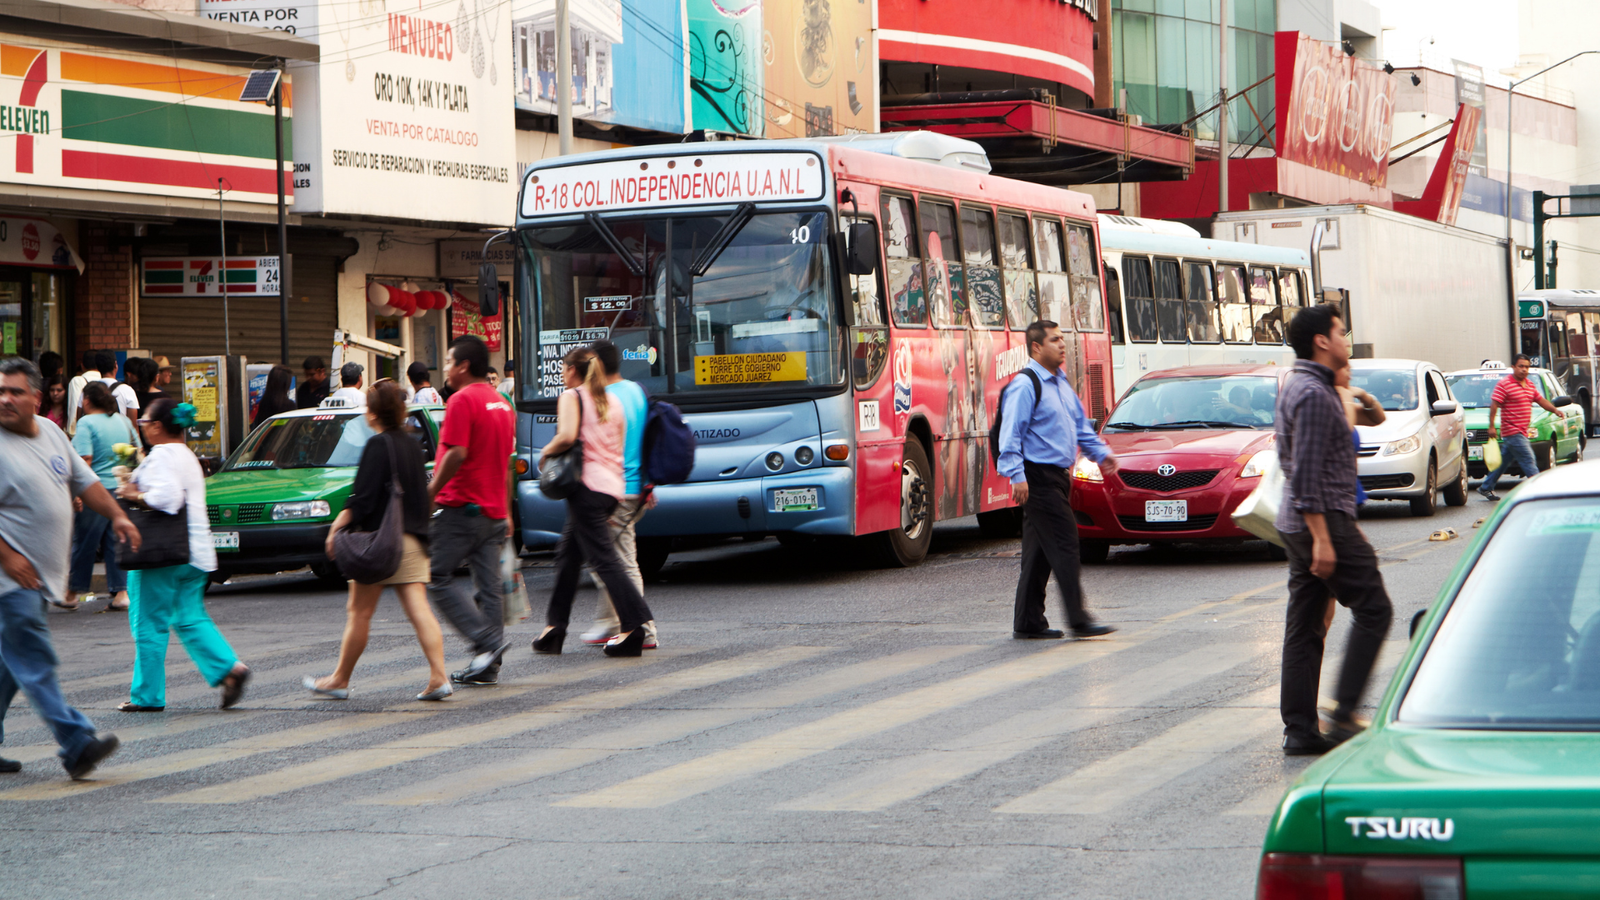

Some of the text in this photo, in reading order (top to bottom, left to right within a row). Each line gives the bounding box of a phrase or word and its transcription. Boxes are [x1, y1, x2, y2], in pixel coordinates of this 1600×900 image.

[208, 8, 298, 23] VENTA POR
[388, 13, 453, 61] MENUDEO
[374, 72, 393, 102] ORO
[417, 78, 433, 108] 14K
[435, 82, 441, 109] Y
[444, 82, 469, 113] PLATA
[366, 118, 478, 147] VENTA POR CATALOGO
[333, 149, 367, 169] SERVICIO
[369, 153, 379, 170] DE
[381, 154, 425, 174] REPARACION
[426, 159, 431, 175] Y
[432, 160, 469, 179] HECHURAS
[470, 163, 508, 183] ESPECIALES
[535, 183, 569, 212] R-18
[747, 168, 805, 196] U.A.N.L
[461, 250, 504, 261] FARMCIAS
[265, 269, 279, 283] 24
[543, 344, 559, 359] NVA.
[709, 353, 786, 365] PABELLON CIUDADANO
[709, 362, 781, 374] TORRE DE GOBIERNO
[709, 372, 772, 383] MERCADO JUAREZ
[324, 399, 345, 407] TAXI
[693, 428, 741, 439] ATIZADO
[775, 494, 816, 506] 216-019-R
[1146, 506, 1186, 516] SJS-70-90
[1344, 816, 1455, 842] TSURU
